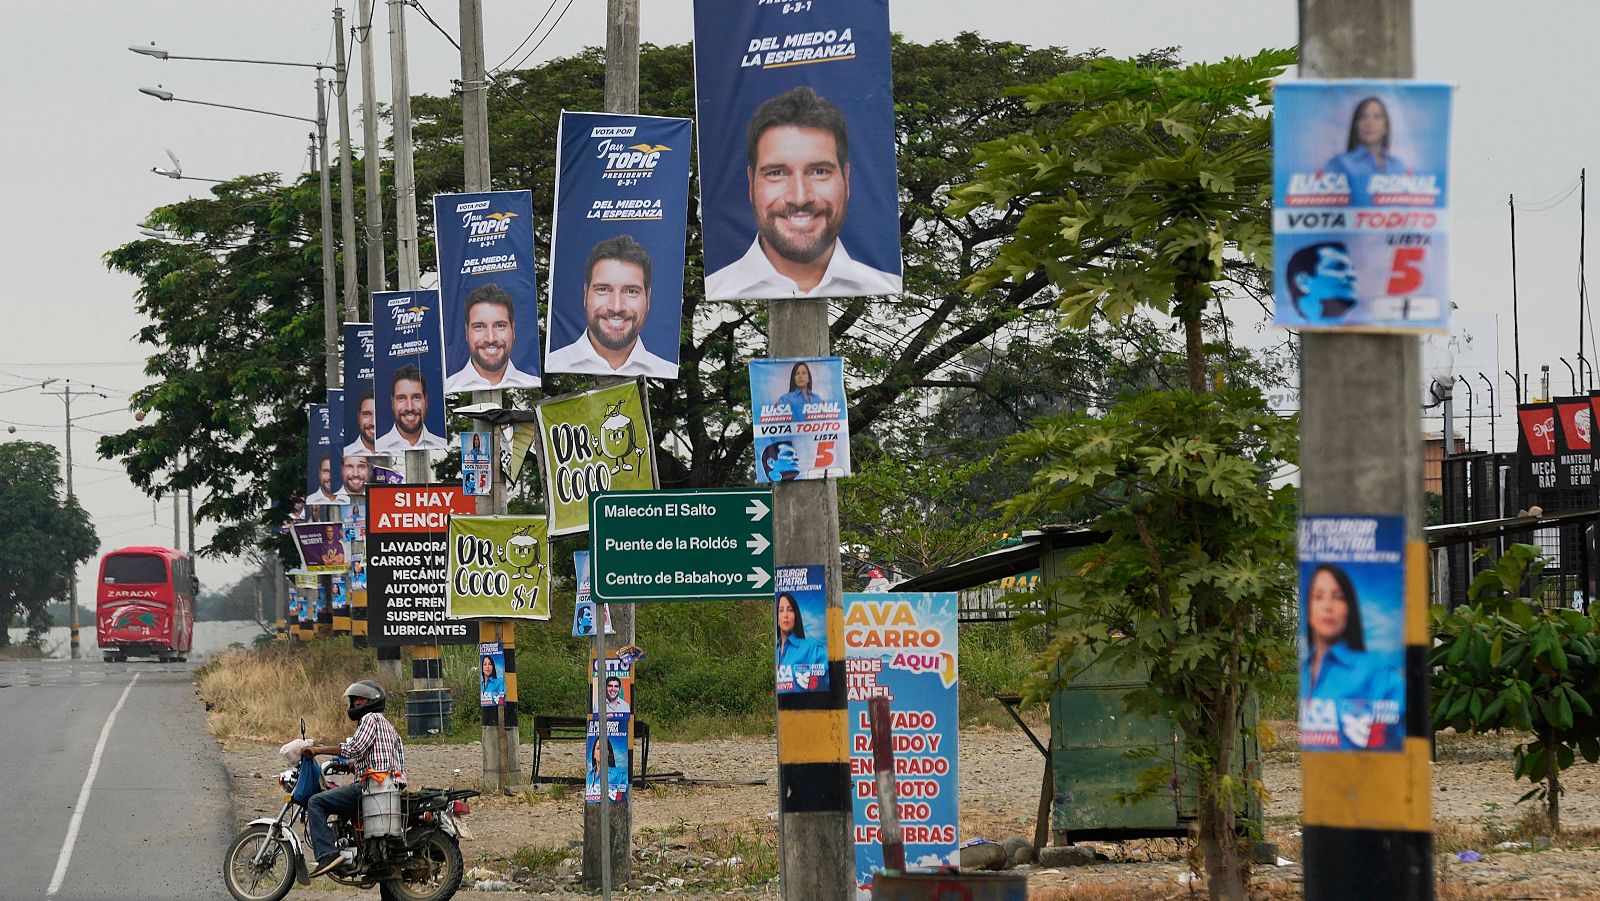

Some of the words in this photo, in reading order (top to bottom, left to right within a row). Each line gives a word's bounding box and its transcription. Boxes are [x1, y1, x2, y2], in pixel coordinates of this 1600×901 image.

[782, 1, 812, 14] 6-3-1
[748, 38, 780, 53] DEL
[783, 30, 838, 48] MIEDO
[839, 28, 852, 42] A
[741, 54, 761, 67] LA
[763, 43, 856, 65] ESPERANZA
[606, 151, 661, 169] TOPIC
[592, 200, 614, 209] DEL
[616, 200, 650, 208] MIEDO
[652, 199, 661, 208] A
[587, 210, 600, 218] LA
[602, 209, 663, 218] ESPERANZA
[1288, 212, 1346, 228] VOTA
[1354, 211, 1437, 228] TODITO
[470, 217, 511, 235] TOPIC
[463, 258, 480, 267] DEL
[481, 255, 507, 265] MIEDO
[472, 261, 517, 273] ESPERANZA
[1386, 247, 1425, 296] 5
[396, 310, 425, 325] TOPIC
[760, 403, 793, 417] LUISA
[802, 401, 842, 415] RONAL
[761, 424, 792, 435] VOTA
[796, 421, 840, 433] TODITO
[814, 441, 835, 468] 5
[480, 474, 486, 488] 5
[1570, 475, 1579, 485] DE
[394, 492, 411, 507] SI
[416, 491, 454, 507] HAY
[604, 504, 663, 518] Malecón
[665, 504, 678, 516] El
[680, 503, 717, 517] Salto
[605, 538, 654, 551] Puente
[655, 537, 673, 550] de
[676, 537, 687, 550] la
[690, 536, 738, 550] Roldós
[370, 556, 421, 567] CARROS
[423, 556, 432, 566] Y
[605, 572, 653, 585] Centro
[654, 571, 672, 584] de
[674, 570, 743, 586] Babahoyo
[783, 576, 808, 586] PATRIA
[107, 590, 158, 598] ZARACAY
[511, 585, 539, 611] $1
[386, 597, 412, 608] ABC
[383, 624, 467, 636] LUBRICANTES
[846, 629, 941, 648] CARRO
[892, 653, 940, 671] AQUI
[847, 673, 876, 688] ITE
[855, 735, 925, 752] RIDO
[927, 735, 940, 752] Y
[850, 758, 948, 774] ENRADO
[895, 781, 939, 798] OTO
